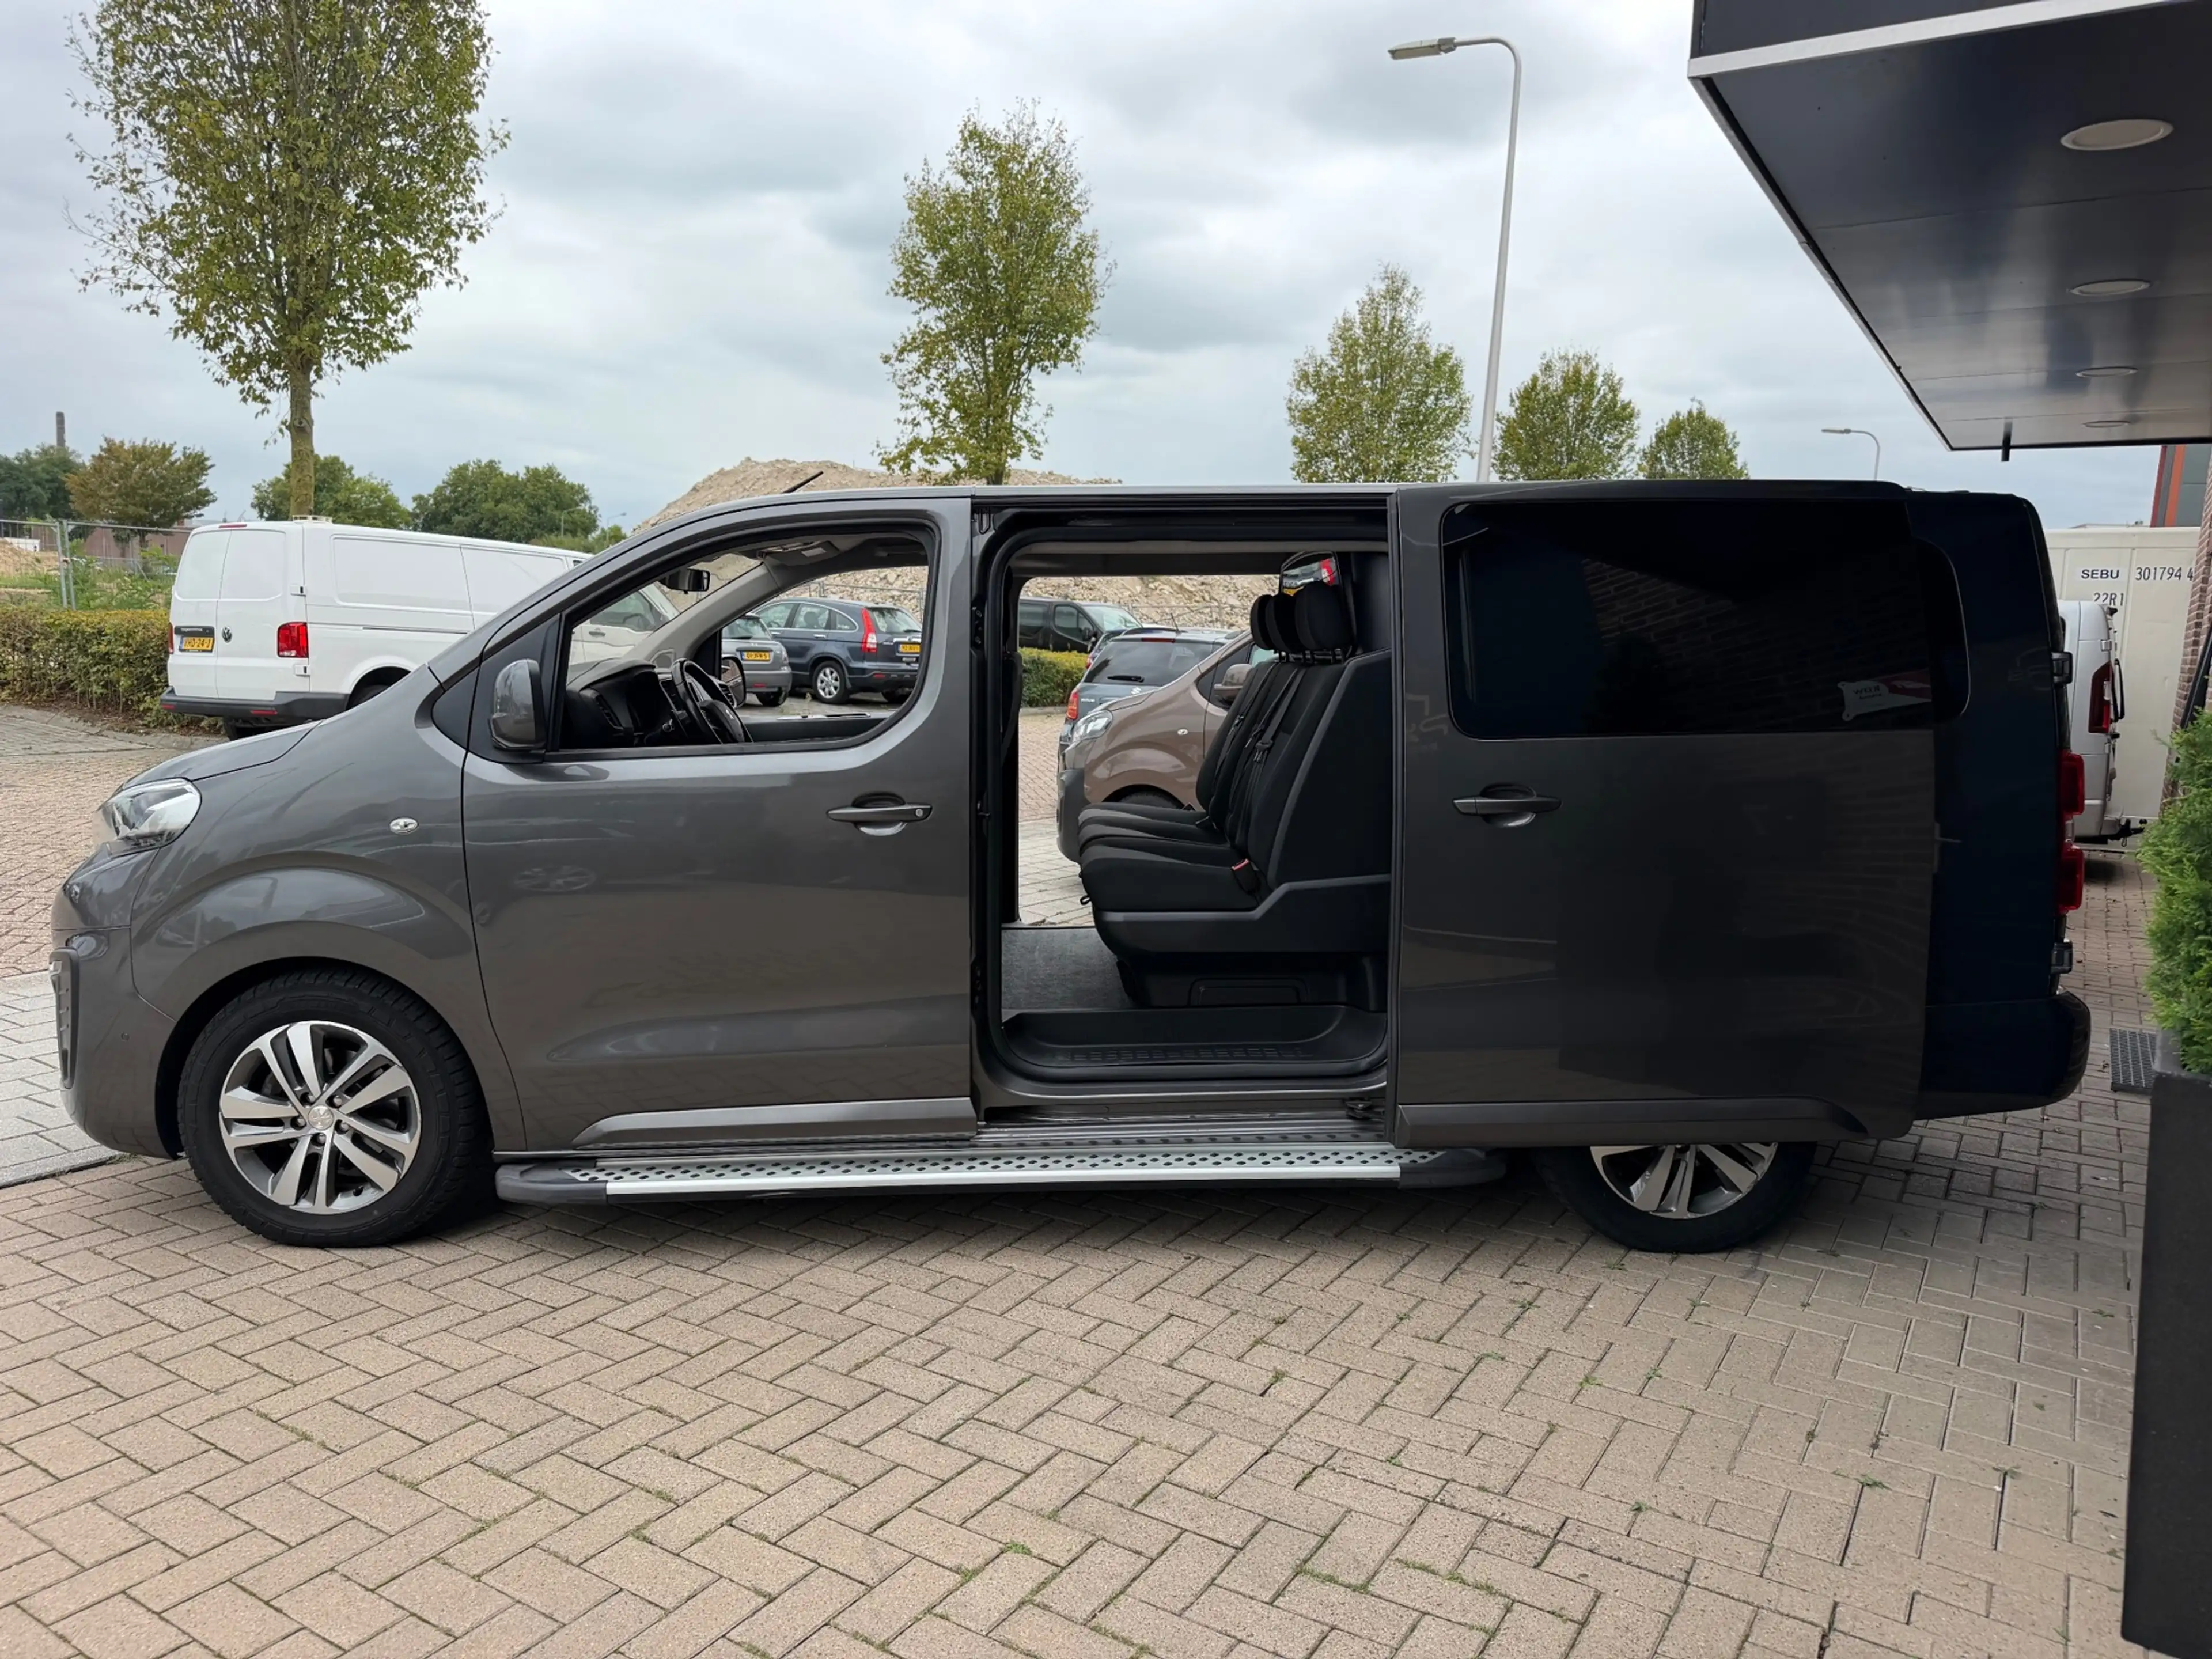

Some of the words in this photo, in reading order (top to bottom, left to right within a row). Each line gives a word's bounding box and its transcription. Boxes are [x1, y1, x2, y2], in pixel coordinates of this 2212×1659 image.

[2081, 569, 2120, 579] SEBU
[2135, 566, 2183, 581] 301794
[2187, 567, 2194, 582] 4
[2093, 592, 2124, 606] 22R1
